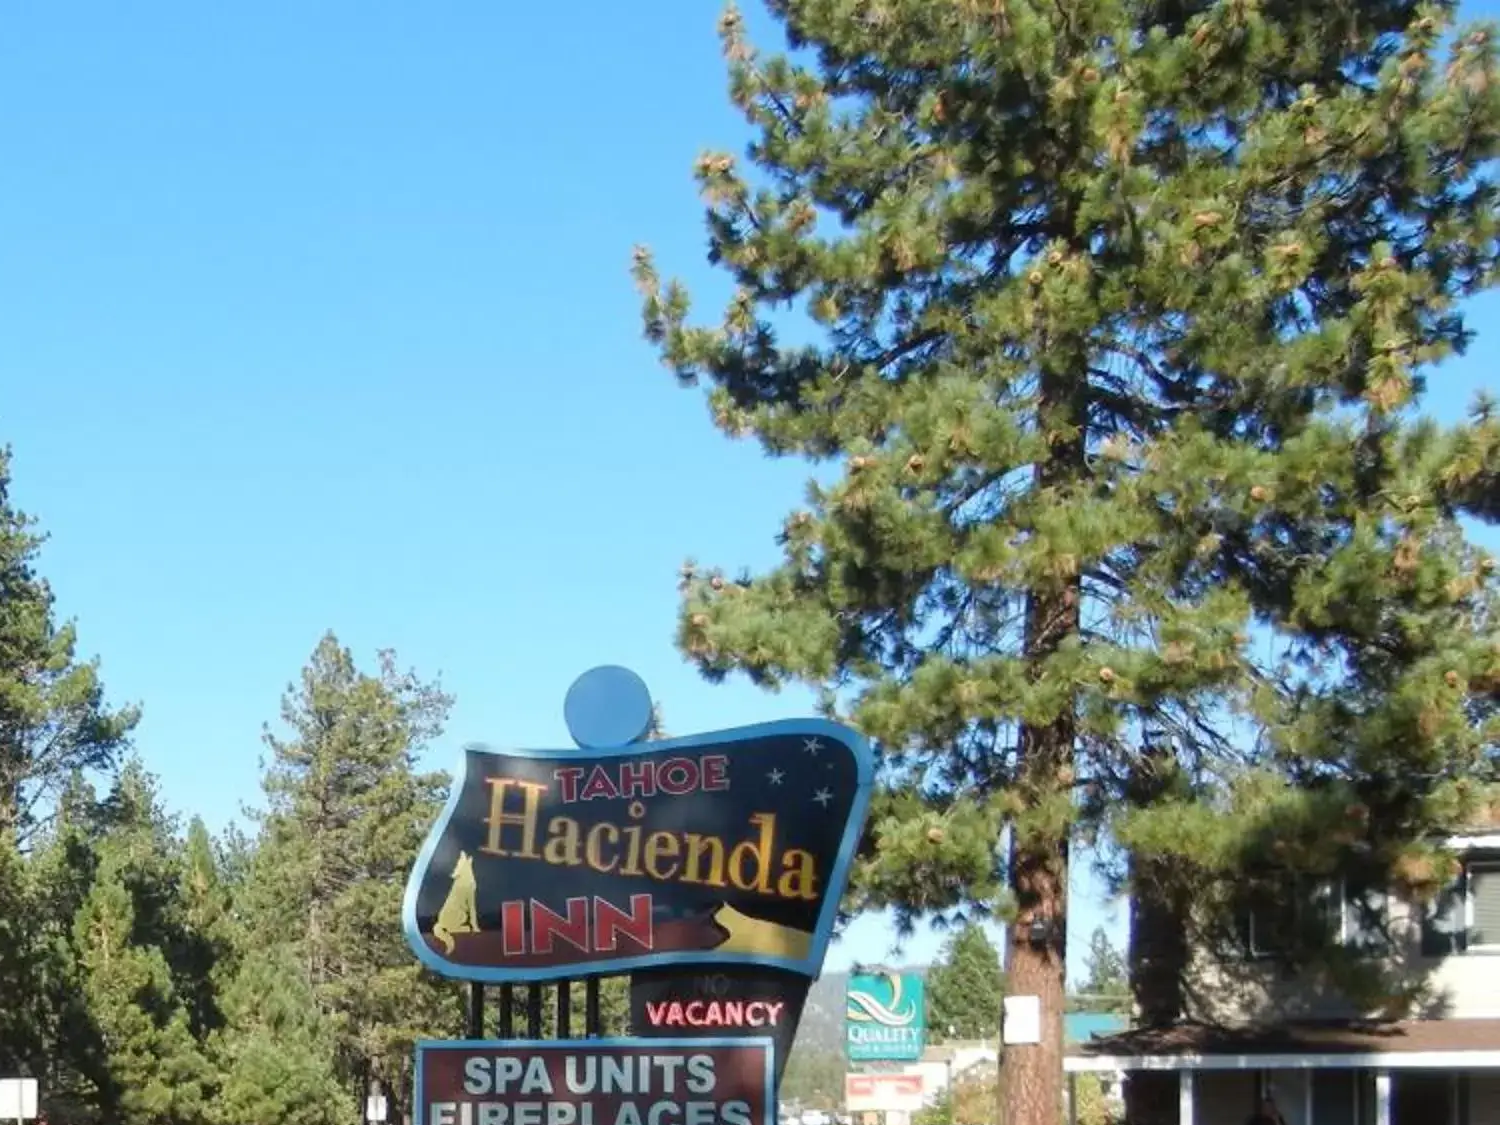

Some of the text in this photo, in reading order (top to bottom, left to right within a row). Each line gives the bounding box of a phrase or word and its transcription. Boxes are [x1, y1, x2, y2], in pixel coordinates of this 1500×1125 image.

[554, 756, 730, 803] TAHOE
[479, 777, 819, 900] Hacienda
[501, 894, 653, 956] INN
[645, 1001, 784, 1027] VACANCY
[848, 1025, 920, 1044] QUALITY
[463, 1054, 716, 1095] SPA UNITS
